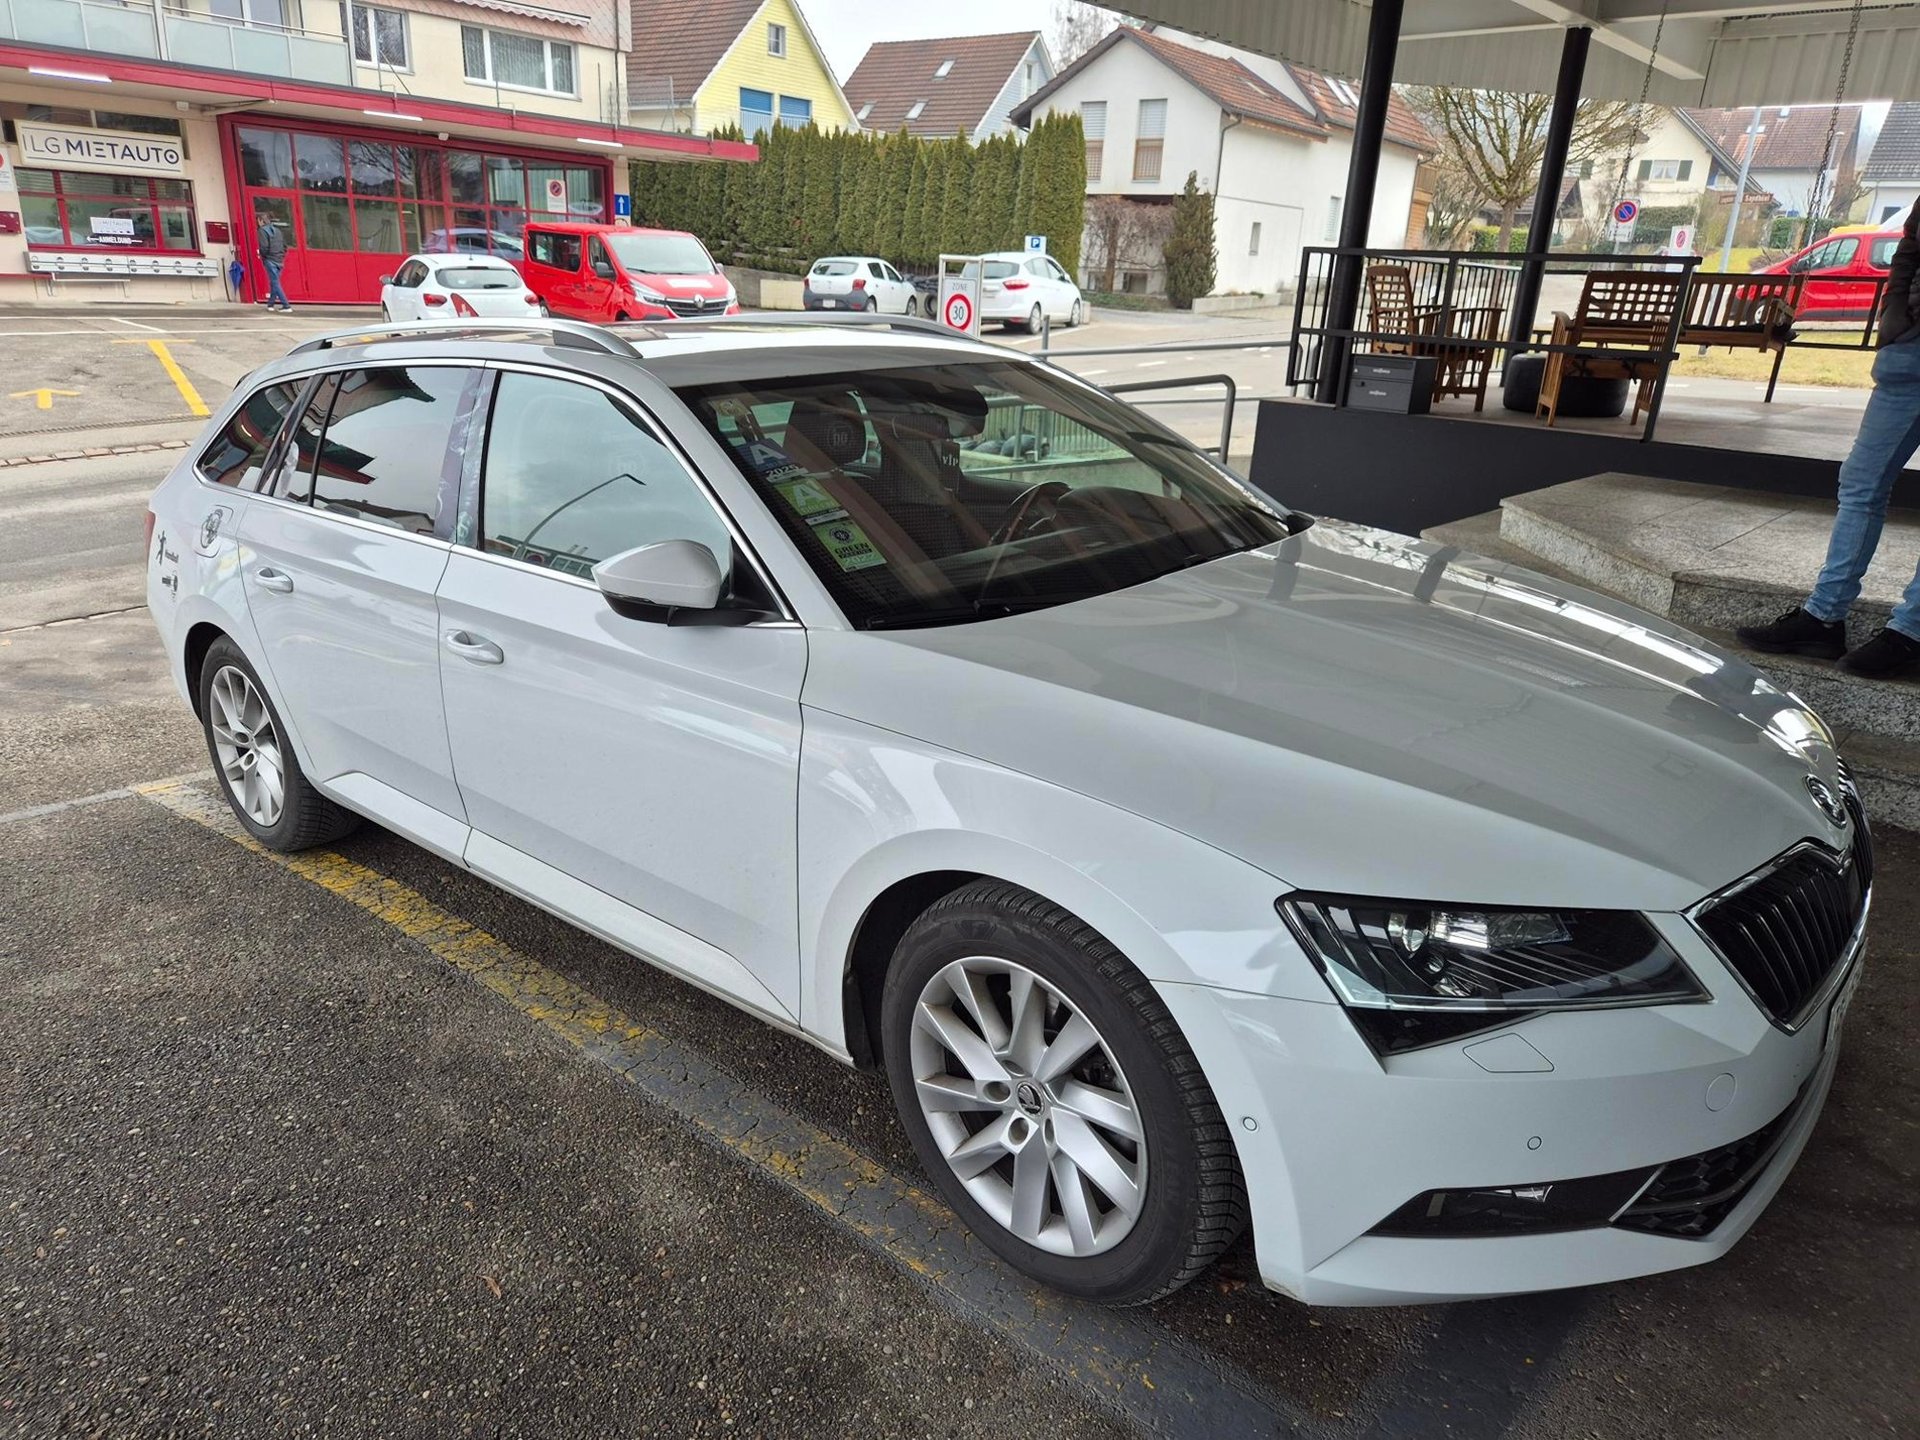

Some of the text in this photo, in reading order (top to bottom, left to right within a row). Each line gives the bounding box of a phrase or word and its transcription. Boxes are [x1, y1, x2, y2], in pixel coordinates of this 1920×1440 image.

[22, 134, 180, 165] ILG MIETAUTO
[1033, 238, 1039, 247] P
[952, 282, 967, 291] ZONE
[953, 305, 965, 320] 30
[750, 444, 787, 465] A
[793, 484, 828, 506] A
[835, 542, 870, 555] GREEN
